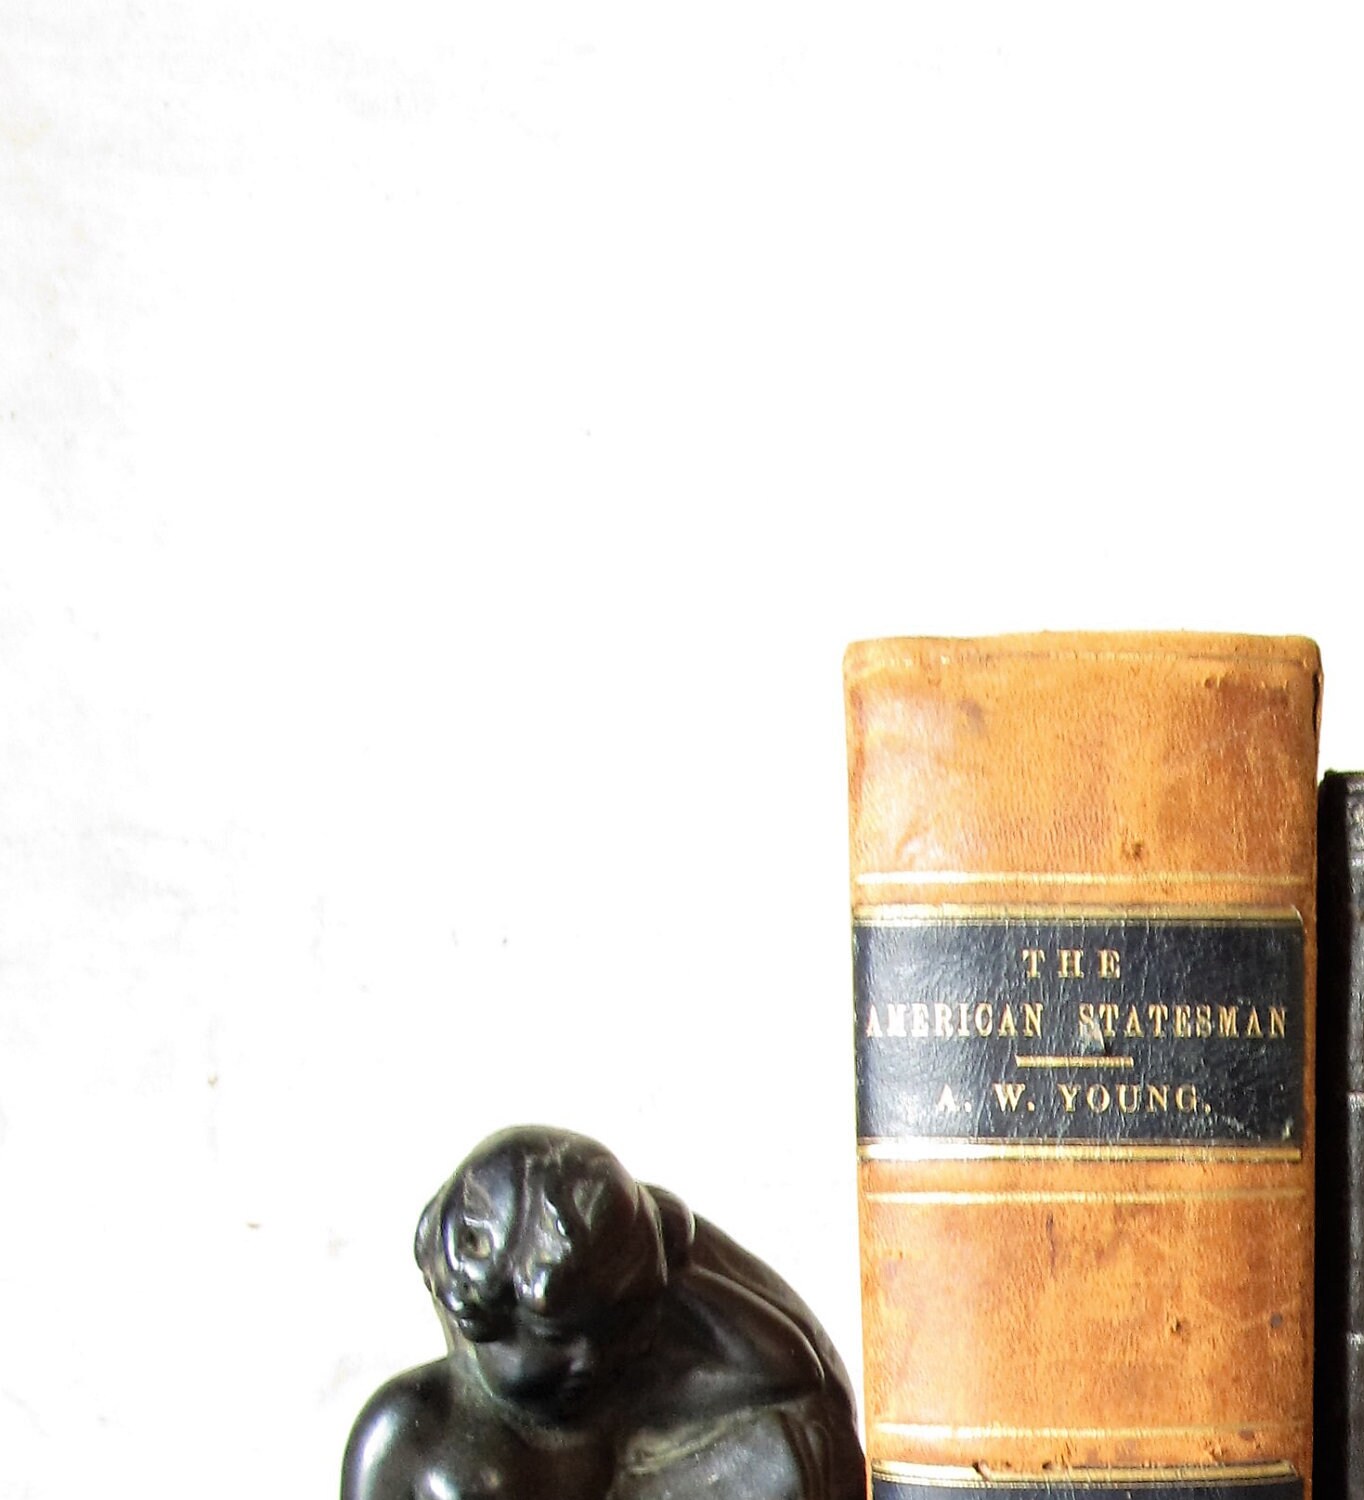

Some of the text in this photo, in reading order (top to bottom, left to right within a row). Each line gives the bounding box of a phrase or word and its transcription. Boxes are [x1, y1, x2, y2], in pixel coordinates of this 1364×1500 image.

[1022, 948, 1122, 980] THE
[865, 1002, 1286, 1040] AMERICAN STATESMAN
[936, 1083, 1213, 1113] A. W. YOUNG.
